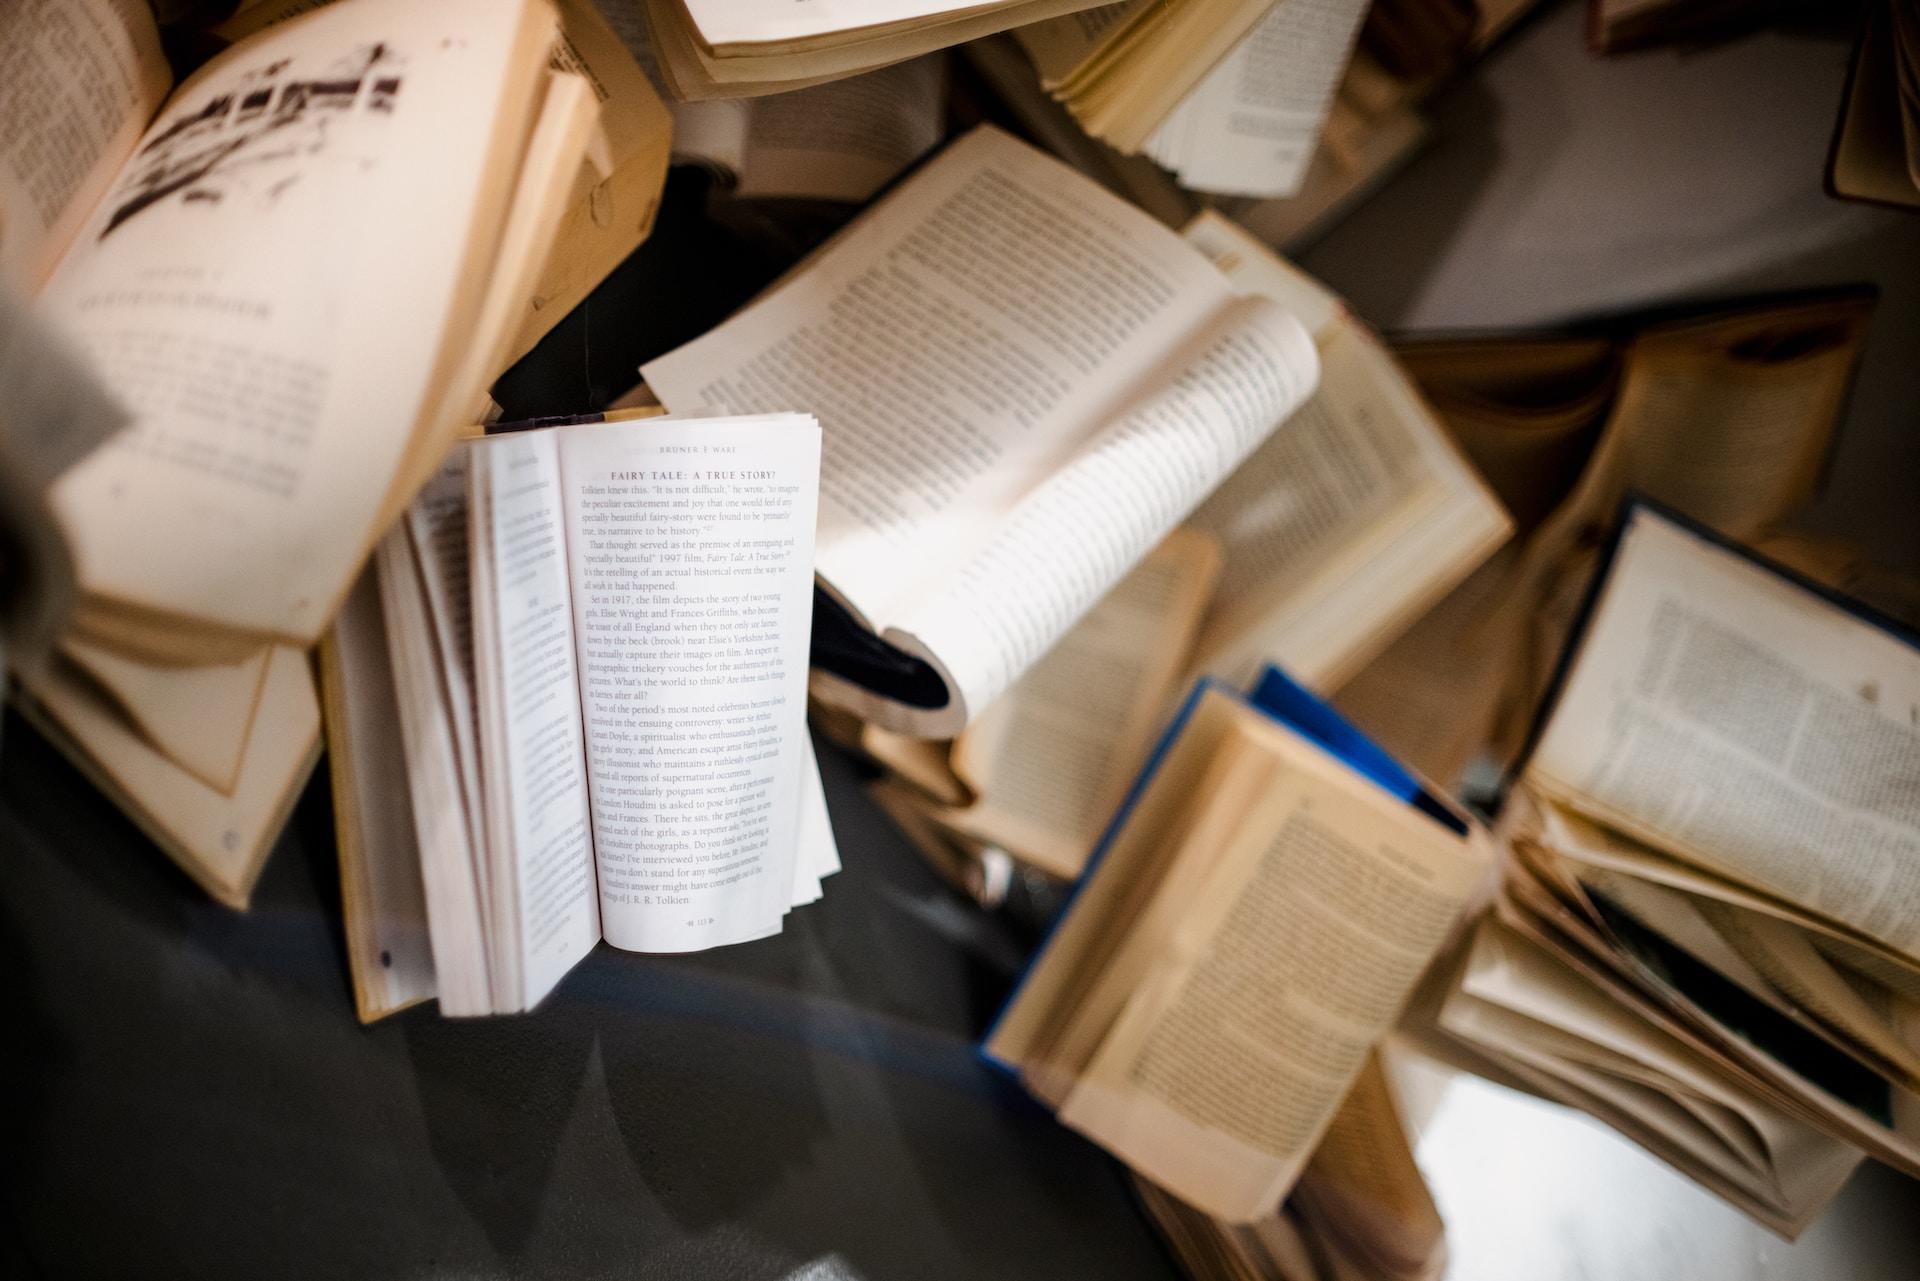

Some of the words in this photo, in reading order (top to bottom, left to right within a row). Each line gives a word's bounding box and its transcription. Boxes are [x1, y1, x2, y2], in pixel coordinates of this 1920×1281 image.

[612, 472, 645, 481] FAIRY
[652, 471, 688, 480] TALE:
[694, 471, 700, 480] A
[706, 471, 736, 480] TRUE
[740, 471, 776, 480] STORY?
[608, 484, 628, 494] knew
[666, 486, 672, 494] is
[676, 485, 689, 494] not
[733, 483, 742, 493] he
[592, 498, 620, 511] peculiar
[624, 499, 669, 508] excitement
[672, 497, 688, 508] and
[692, 500, 704, 510] joy
[708, 497, 722, 507] that
[742, 496, 762, 507] would
[611, 511, 646, 521] beautiful
[650, 511, 693, 524] fairy-story
[720, 510, 741, 521] found
[744, 512, 750, 520] to
[753, 510, 760, 520] be
[608, 527, 642, 536] narrative
[646, 527, 654, 535] to
[658, 525, 666, 535] be
[590, 539, 604, 549] That
[606, 539, 637, 552] thought
[640, 539, 668, 549] served
[683, 539, 696, 549] the
[700, 540, 730, 551] premise
[733, 538, 740, 548] of
[660, 552, 680, 562] 1997
[684, 552, 704, 564] film,
[707, 552, 727, 565] Fairy
[748, 551, 753, 561] A
[594, 566, 604, 576] the
[606, 566, 638, 579] retelling
[641, 567, 648, 577] of
[665, 567, 690, 577] actual
[694, 566, 731, 576] historical
[733, 566, 752, 576] event
[616, 580, 630, 590] had
[632, 580, 677, 593] happened.
[636, 594, 649, 604] the
[653, 594, 670, 604] film
[673, 594, 704, 607] depicts
[706, 593, 719, 603] the
[722, 594, 739, 606] story
[741, 592, 748, 602] of
[620, 607, 648, 620] Wright
[651, 607, 668, 617] and
[671, 607, 704, 617] Frances
[613, 621, 620, 631] of
[622, 621, 632, 632] all
[635, 621, 670, 634] England
[674, 621, 697, 631] when
[700, 620, 717, 634] they
[720, 621, 732, 630] not
[734, 619, 748, 632] only
[604, 635, 612, 647] by
[614, 635, 626, 645] the
[628, 635, 648, 645] beck
[651, 635, 684, 648] (brook)
[709, 634, 732, 644] Elsie's
[598, 648, 624, 661] actually
[626, 650, 657, 661] capture
[660, 649, 680, 659] their
[684, 650, 712, 661] images
[588, 661, 628, 675] photographic
[632, 662, 666, 675] trickery
[668, 662, 704, 672] vouches
[706, 662, 717, 672] for
[720, 660, 731, 671] the
[614, 676, 641, 686] What's
[644, 676, 658, 686] the
[660, 676, 686, 686] world
[690, 678, 698, 686] to
[700, 675, 725, 686] think?
[614, 689, 632, 700] after
[634, 690, 648, 700] all?
[609, 702, 616, 713] of
[618, 703, 630, 713] the
[632, 703, 666, 716] period's
[668, 704, 688, 713] most
[692, 702, 715, 713] noted
[616, 718, 622, 727] in
[624, 717, 636, 727] the
[638, 719, 672, 730] ensuing
[640, 730, 686, 743] spiritualist
[690, 730, 706, 740] who
[638, 744, 654, 754] and
[656, 744, 697, 754] American
[700, 745, 724, 756] escape
[643, 758, 662, 768] who
[664, 759, 706, 768] maintains
[622, 772, 648, 784] reports
[651, 771, 660, 781] of
[662, 770, 714, 784] supernatural
[618, 784, 662, 798] particularly
[666, 786, 704, 798] poignant
[624, 799, 656, 809] Houdini
[660, 800, 666, 809] is
[669, 799, 694, 809] asked
[696, 800, 705, 809] to
[708, 799, 724, 810] pose
[654, 813, 679, 823] There
[682, 812, 692, 823] he
[712, 810, 722, 821] the
[614, 823, 628, 835] each
[630, 825, 639, 836] of
[641, 826, 654, 836] the
[657, 826, 676, 839] girls,
[635, 839, 688, 852] photographs.
[694, 839, 705, 849] Do
[708, 839, 720, 851] you
[628, 852, 640, 863] I've
[643, 853, 692, 863] interviewed
[696, 854, 710, 865] you
[628, 866, 648, 877] don't
[651, 867, 674, 877] stand
[677, 867, 688, 877] for
[692, 868, 706, 879] any
[662, 880, 688, 893] might
[691, 878, 708, 890] have
